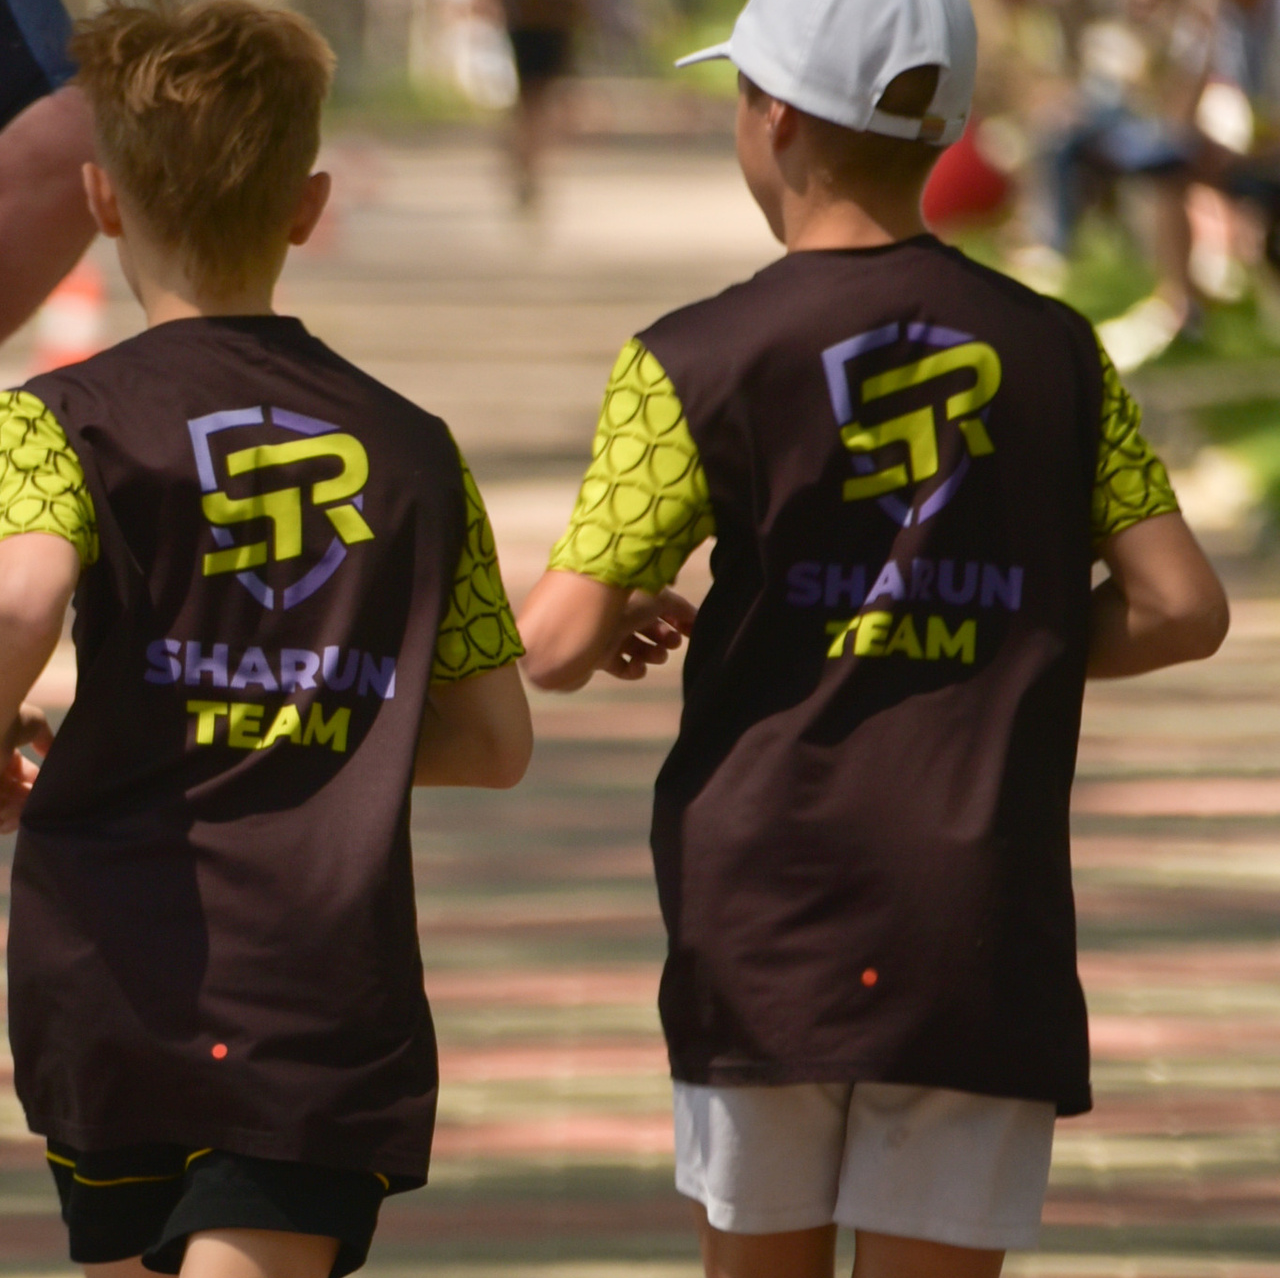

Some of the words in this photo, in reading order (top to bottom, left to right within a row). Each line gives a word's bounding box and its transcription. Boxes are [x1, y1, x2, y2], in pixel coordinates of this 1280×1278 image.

[786, 559, 1024, 611] SHARUN
[825, 610, 977, 663] TEAM
[143, 638, 396, 700] SHARUN
[186, 699, 352, 753] TEAM
